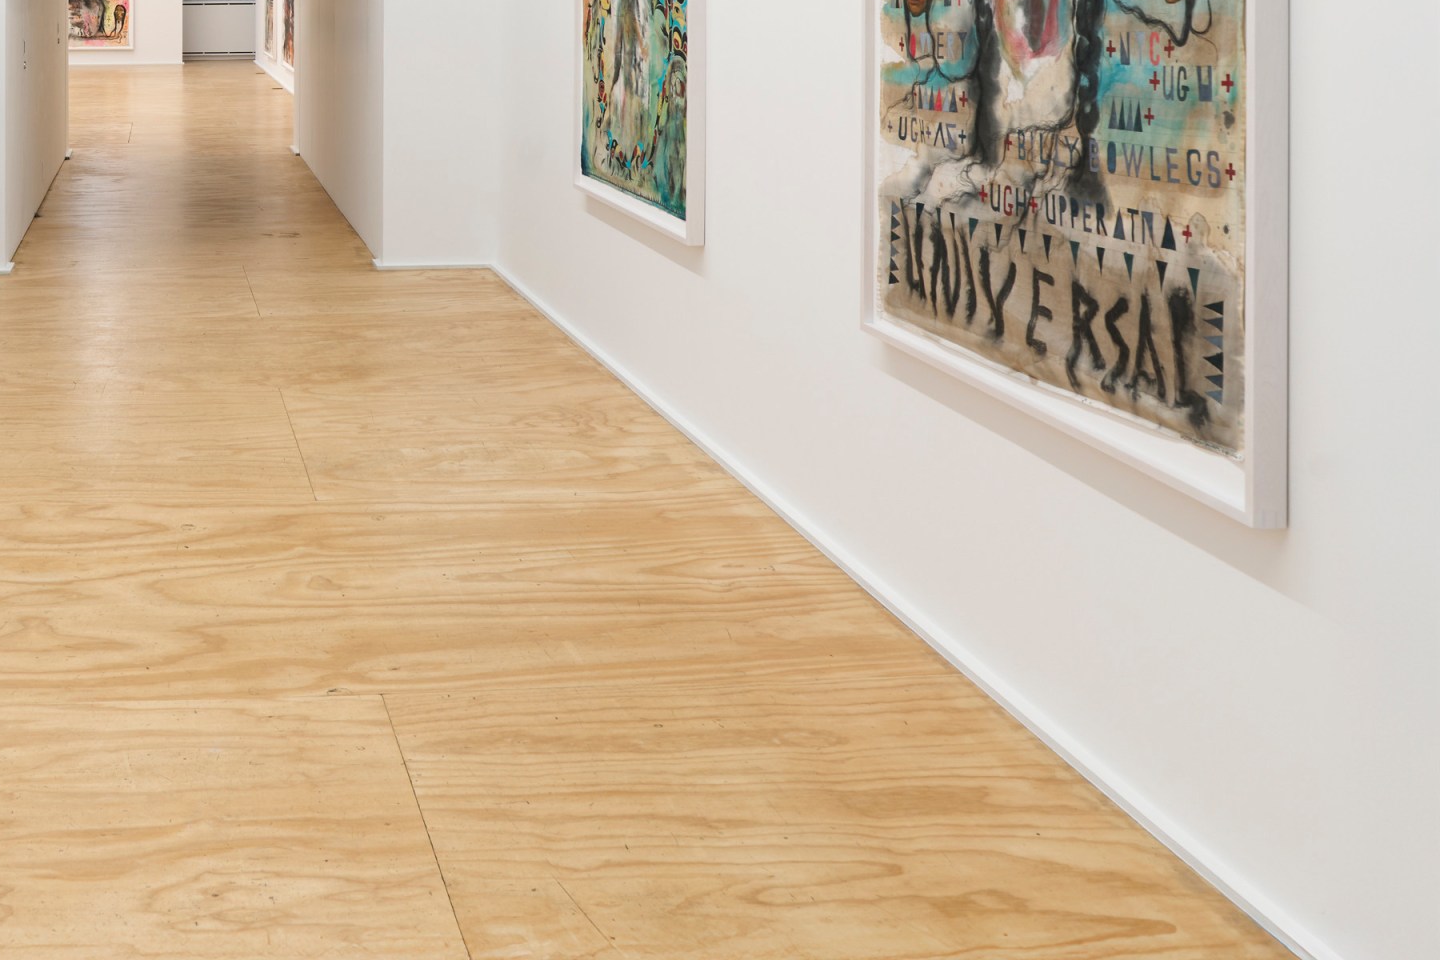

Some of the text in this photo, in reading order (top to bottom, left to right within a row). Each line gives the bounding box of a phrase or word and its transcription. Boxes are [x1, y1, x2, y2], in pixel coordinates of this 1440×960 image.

[1120, 31, 1160, 66] NYC
[1163, 65, 1212, 102] UGH
[898, 116, 926, 143] UGH
[1017, 129, 1221, 188] BILLY BOWLEGS
[990, 183, 1027, 217] UGH
[1045, 192, 1108, 237] UPPER
[900, 198, 1210, 428] UNIVERSAL
